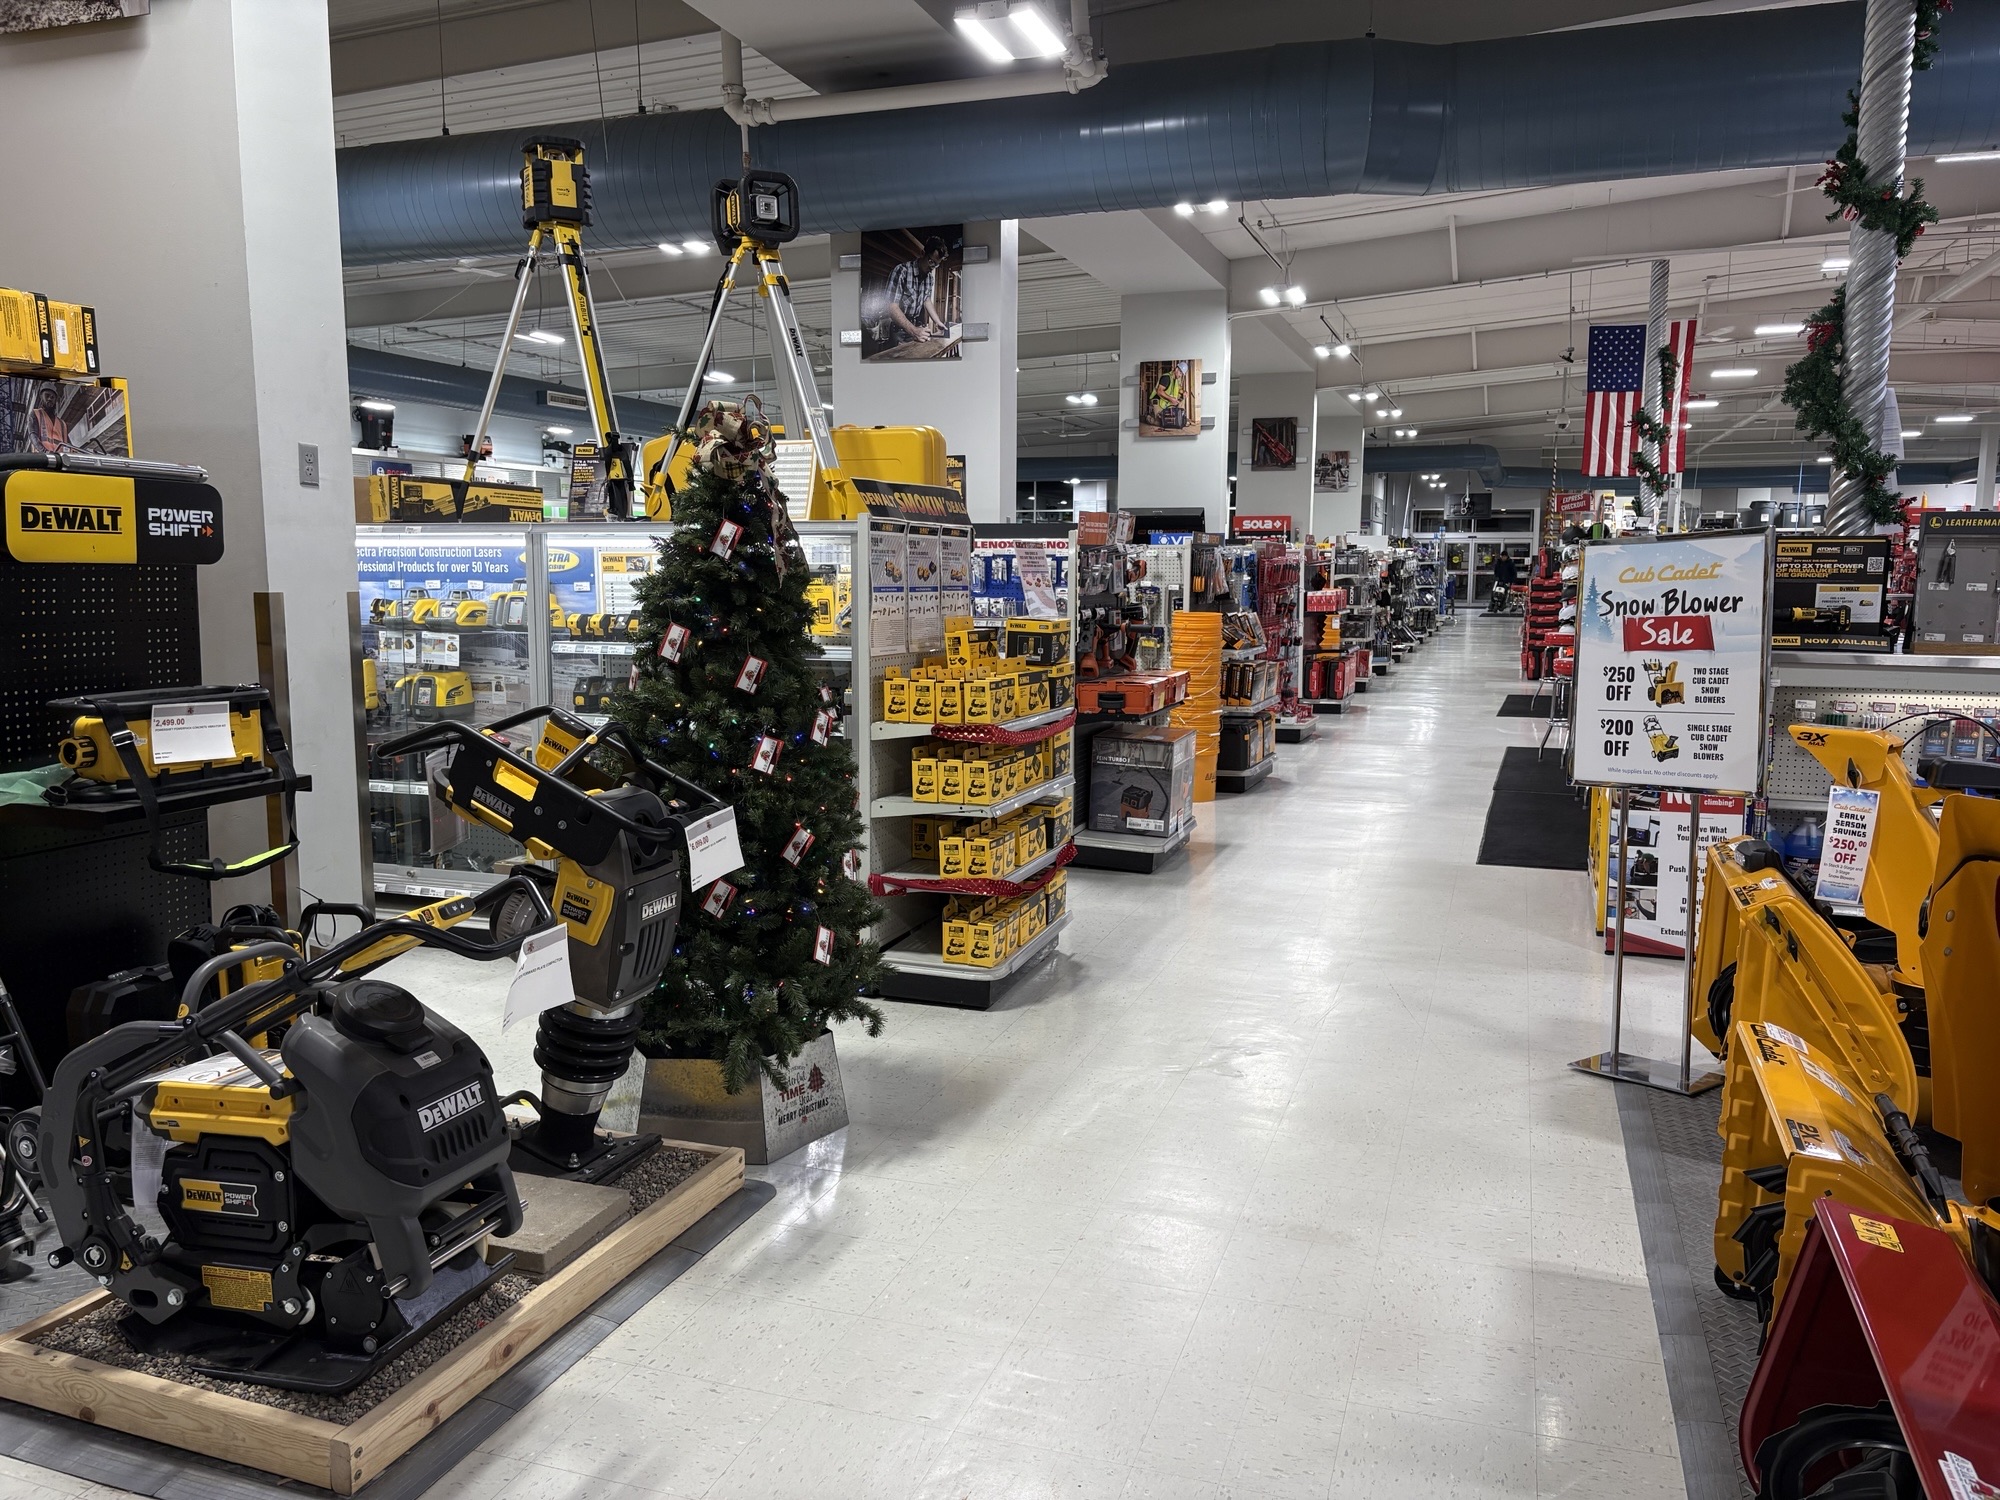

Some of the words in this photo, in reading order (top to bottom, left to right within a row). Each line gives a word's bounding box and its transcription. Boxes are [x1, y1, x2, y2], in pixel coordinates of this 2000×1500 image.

[577, 296, 588, 322] STABILA
[37, 300, 48, 334] DEWALT
[84, 312, 94, 345] DEWALT
[788, 327, 804, 358] DEWALT
[390, 476, 400, 509] DEWALT
[1562, 494, 1584, 503] EXPRESS
[860, 492, 898, 508] DEWALT
[894, 492, 947, 517] SMOKIN'
[946, 500, 968, 514] DEALS
[1561, 501, 1586, 510] CHECKOUT
[20, 506, 122, 532] DEWALT
[148, 508, 214, 524] POWER
[509, 510, 542, 522] DEWALT
[148, 524, 202, 538] SHIFT
[974, 540, 1014, 549] LENOX
[379, 547, 418, 558] Precision
[418, 547, 472, 558] Construction
[474, 547, 502, 558] Lasers
[398, 561, 434, 572] Products
[436, 561, 452, 572] for
[453, 562, 470, 572] over
[472, 562, 482, 572] 50
[484, 562, 509, 573] Years
[1618, 566, 1655, 584] Cub
[1658, 562, 1723, 582] Cadet
[1599, 590, 1654, 617] Snow
[1660, 588, 1744, 616] Blower
[1640, 618, 1694, 646] Sale
[1831, 638, 1888, 646] AVAILABLE
[1603, 666, 1635, 683] $250
[1708, 677, 1729, 685] CADET
[1606, 685, 1631, 701] OFF
[1695, 696, 1726, 704] BLOWERS
[1600, 718, 1634, 736] $200
[1687, 724, 1710, 732] SINGLE
[1712, 725, 1732, 733] STAGE
[1707, 734, 1728, 742] CADET
[1797, 732, 1830, 742] 3X
[544, 735, 570, 756] DEWALT
[1604, 740, 1630, 757] OFF
[1699, 743, 1718, 751] SNOW
[1693, 753, 1724, 761] BLOWERS
[472, 786, 515, 818] DEWALT
[1840, 812, 1865, 821] EARLY
[1849, 806, 1872, 814] Cadet
[1710, 826, 1727, 834] What
[1835, 820, 1866, 830] SEASON
[1833, 828, 1867, 838] SAVINGS
[1829, 836, 1867, 851] $250.00
[1834, 852, 1857, 864] OFF
[565, 891, 590, 906] DEWALT
[563, 903, 587, 917] POWER
[642, 892, 678, 920] DEWALT
[562, 908, 582, 919] SHIFT
[1660, 928, 1686, 936] Extends
[1757, 1038, 1788, 1066] Cadet
[779, 1084, 805, 1102] TIME
[418, 1082, 484, 1132] DEWALT
[778, 1110, 797, 1126] MERRY
[798, 1097, 829, 1117] CHRISTMAS
[186, 1189, 222, 1202] DEWALT
[224, 1192, 251, 1200] POWER
